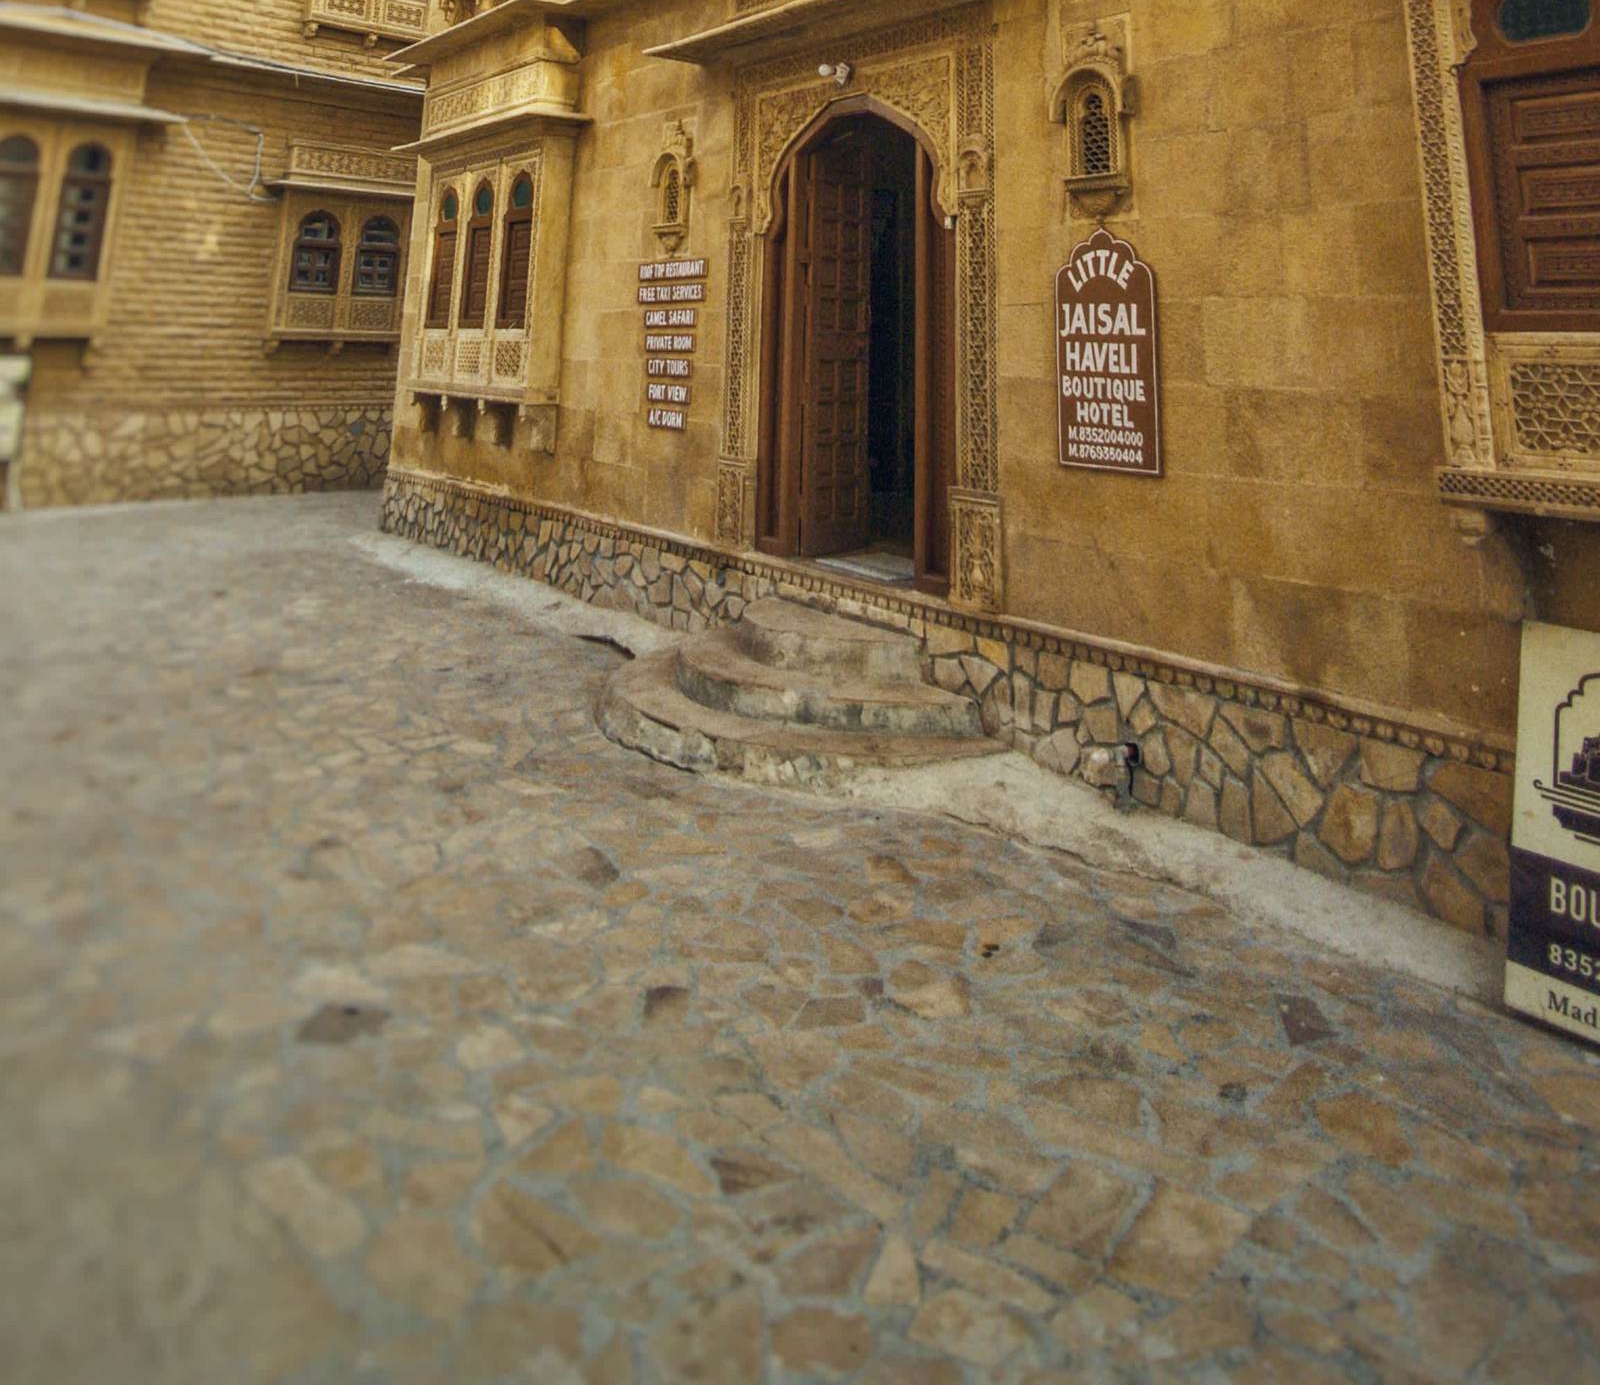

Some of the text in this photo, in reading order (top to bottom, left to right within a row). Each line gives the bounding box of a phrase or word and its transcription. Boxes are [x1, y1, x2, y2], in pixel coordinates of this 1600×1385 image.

[654, 263, 665, 278] TOP
[665, 260, 704, 277] RESTAURANT
[1067, 249, 1135, 292] LITTLE
[639, 284, 702, 303] FREE TAXI SERVICES
[646, 309, 694, 326] CAMEL SAFARI
[1060, 303, 1146, 337] JAISAL
[646, 335, 692, 351] PRIVATE ROOM
[648, 359, 688, 375] CITY TOURS
[1065, 341, 1138, 375] HAVELI
[648, 383, 687, 402] FORT VIEW
[1062, 375, 1146, 403] BOUTIQUE
[662, 411, 683, 428] DORM
[1076, 401, 1135, 429] HOTEL
[1548, 990, 1598, 1028] Mad
